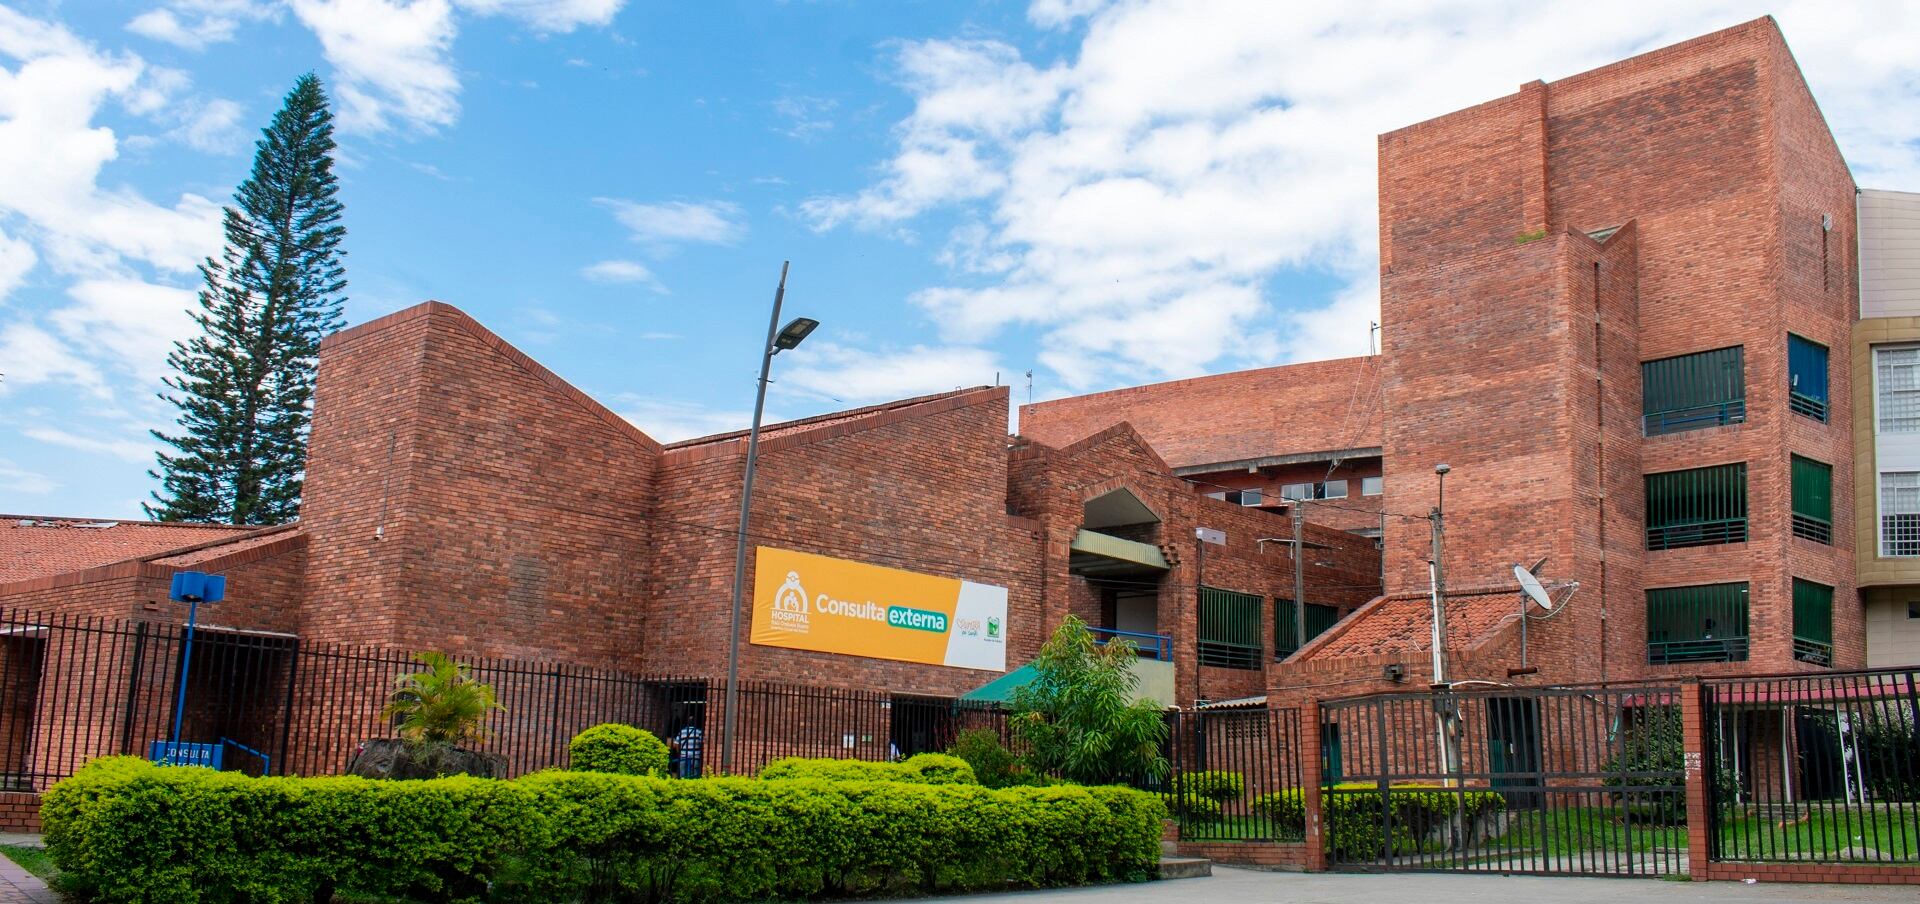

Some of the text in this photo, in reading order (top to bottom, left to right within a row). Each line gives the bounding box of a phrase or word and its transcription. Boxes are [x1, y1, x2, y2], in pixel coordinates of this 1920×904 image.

[771, 610, 809, 623] HOSPITAL
[816, 593, 886, 622] Consulta
[889, 608, 945, 631] externa
